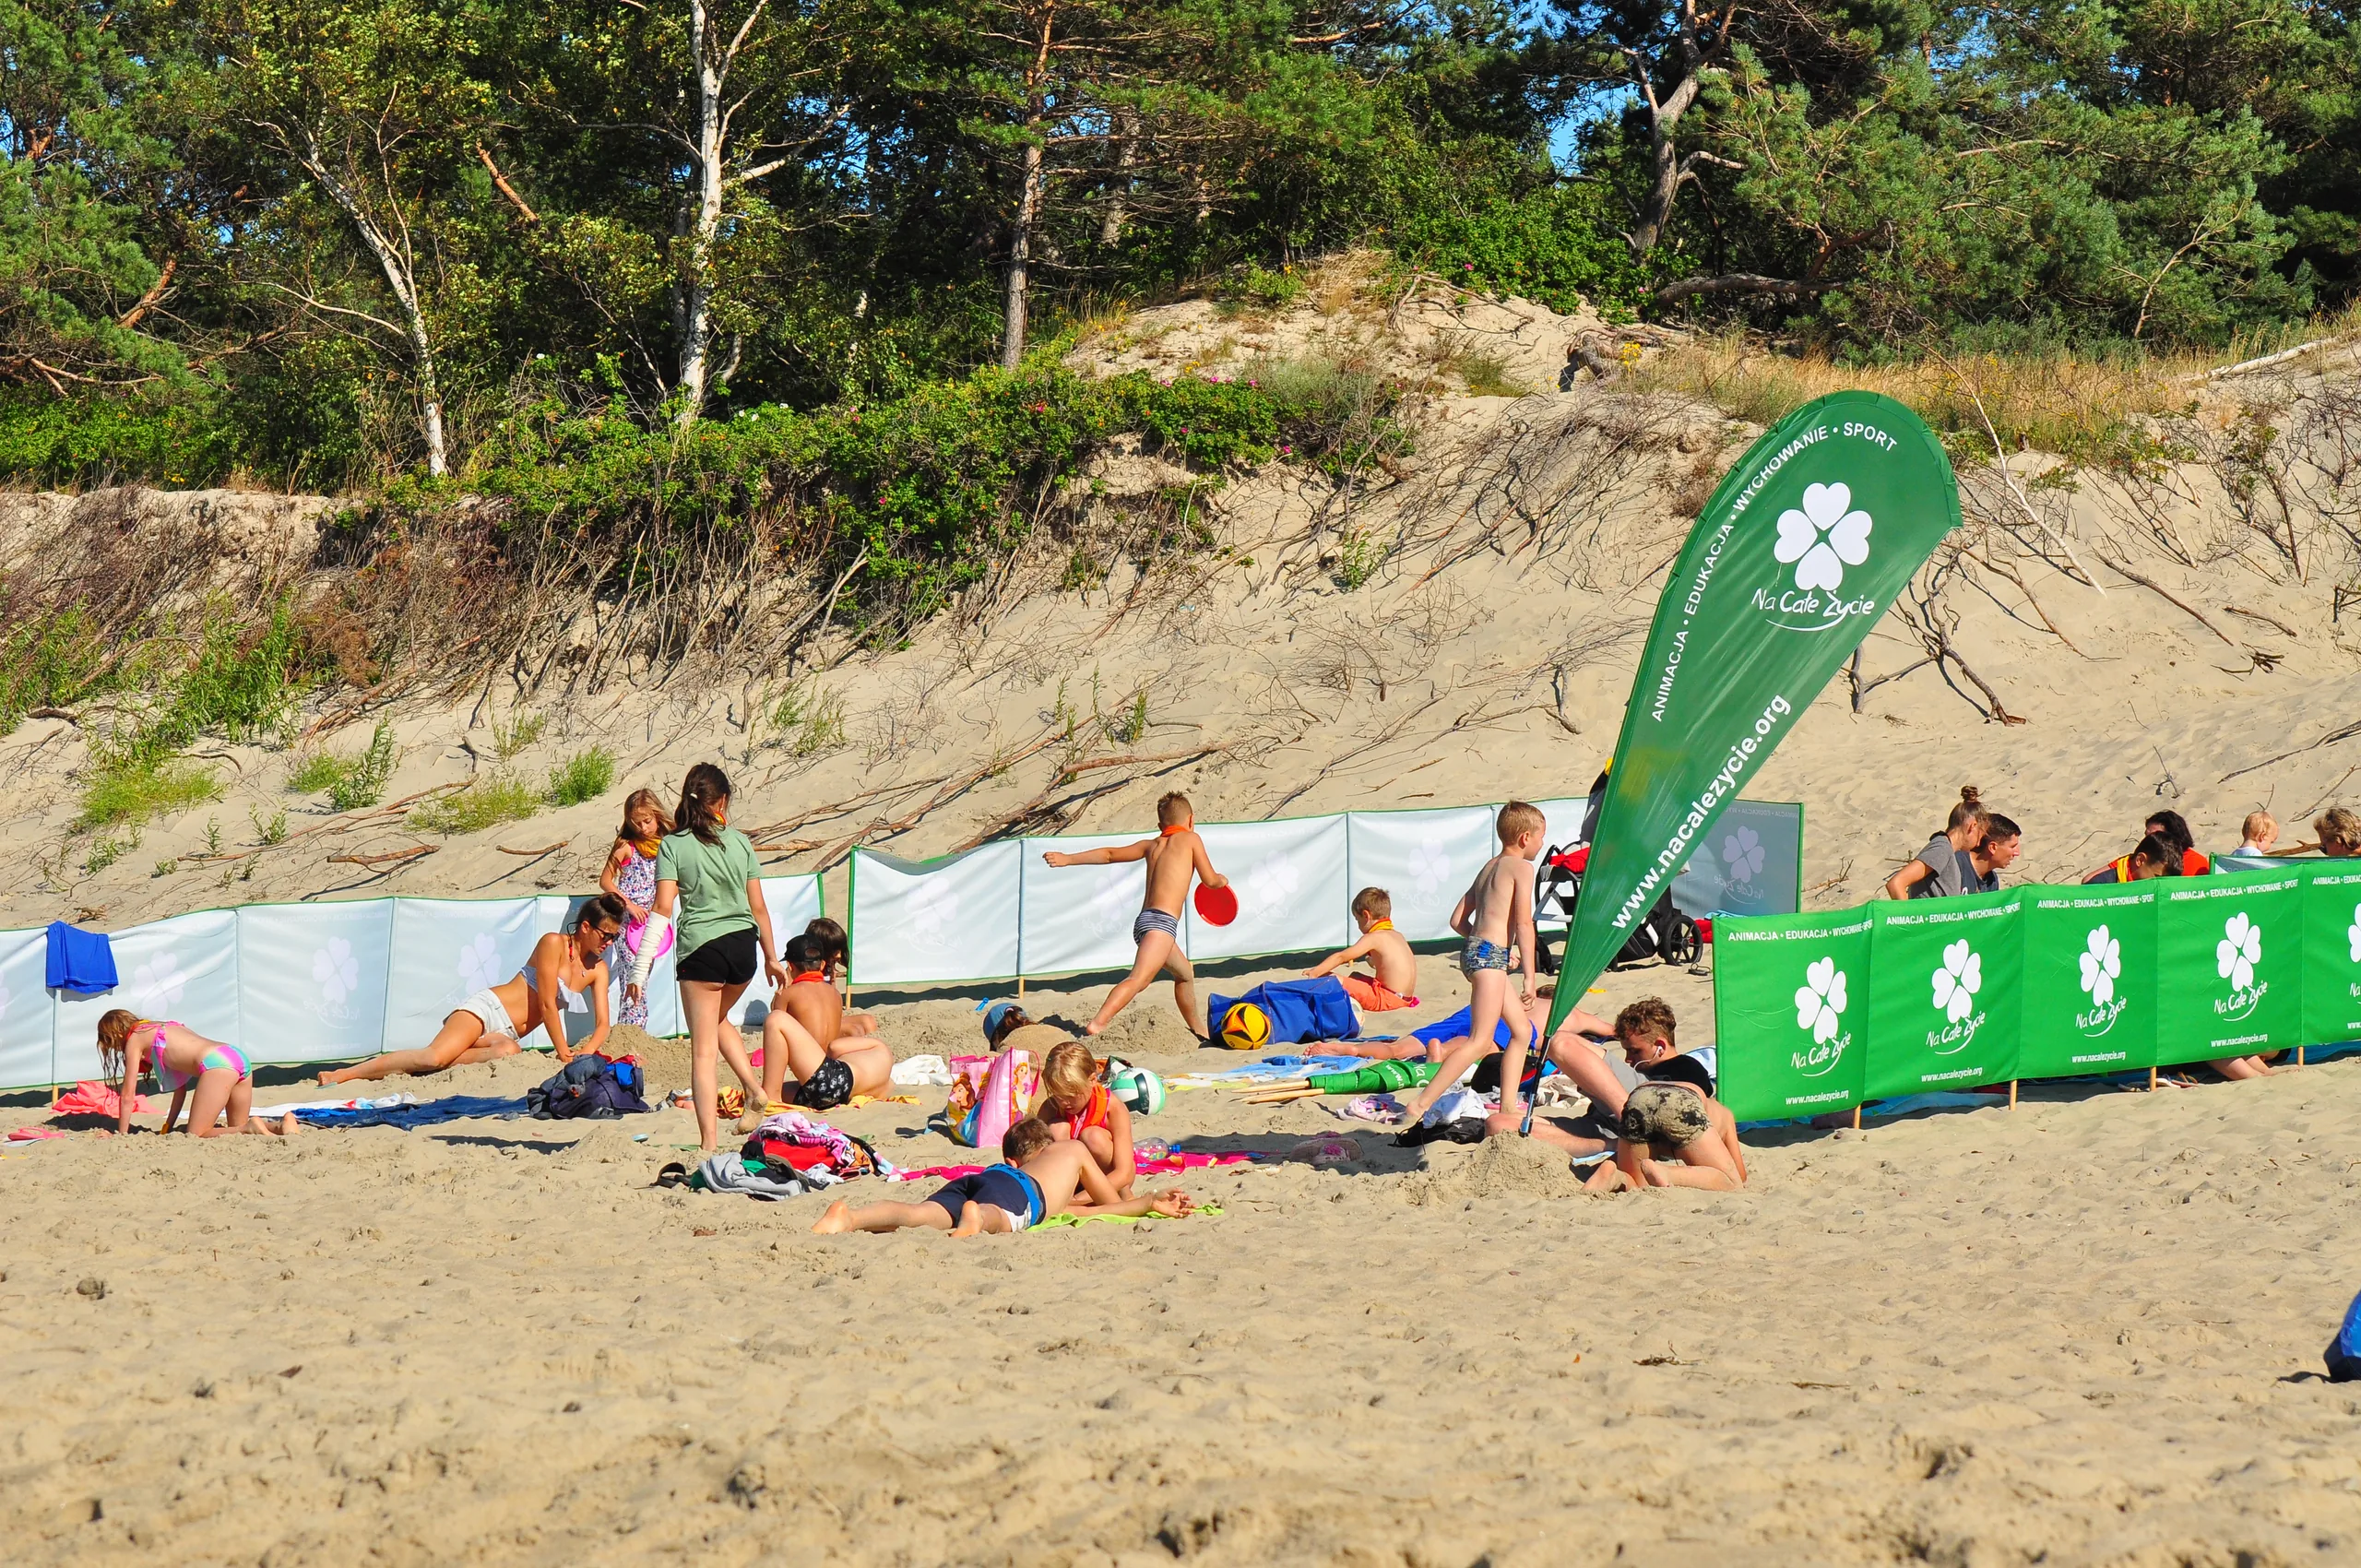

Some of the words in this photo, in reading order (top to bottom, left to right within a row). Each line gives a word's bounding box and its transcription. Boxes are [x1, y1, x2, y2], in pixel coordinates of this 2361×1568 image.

[1652, 631, 1689, 722] ANIMACJA
[1684, 523, 1735, 615] EDUKACJA
[1732, 424, 1829, 512] WYCHOWANIE
[1843, 422, 1898, 453] SPORT
[1751, 588, 1776, 611] Na
[1822, 589, 1875, 618] Życie
[1612, 695, 1791, 929] www.nacalezycie.org
[2312, 876, 2341, 885] ANIMACJA
[2170, 890, 2206, 900] ANIMACJA
[2210, 886, 2243, 897] EDUKACJA
[2247, 882, 2282, 894] WYCHOWANIE
[2284, 879, 2298, 889] SPORT
[2037, 899, 2070, 909] ANIMACJA
[2074, 898, 2104, 908] EDUKACJA
[2141, 894, 2154, 903] SPORT
[1886, 915, 1924, 925] ANIMACJA
[1929, 912, 1964, 922] EDUKACJA
[2005, 902, 2021, 914] SPORT
[1728, 932, 1778, 941] ANIMACJA
[1786, 929, 1828, 940] EDUKACJA
[2349, 982, 2361, 997] Na
[2213, 999, 2226, 1015] Na
[2075, 1013, 2088, 1029] Na
[1926, 1030, 1940, 1048] Na
[2211, 1033, 2268, 1047] www.nacalezycie.org
[1791, 1051, 1807, 1069] Na
[2071, 1051, 2127, 1063] www.nacalezycie.org
[1921, 1067, 1983, 1082] www.nacalezycie.org
[1786, 1089, 1849, 1105] www.nacalezycie.org
